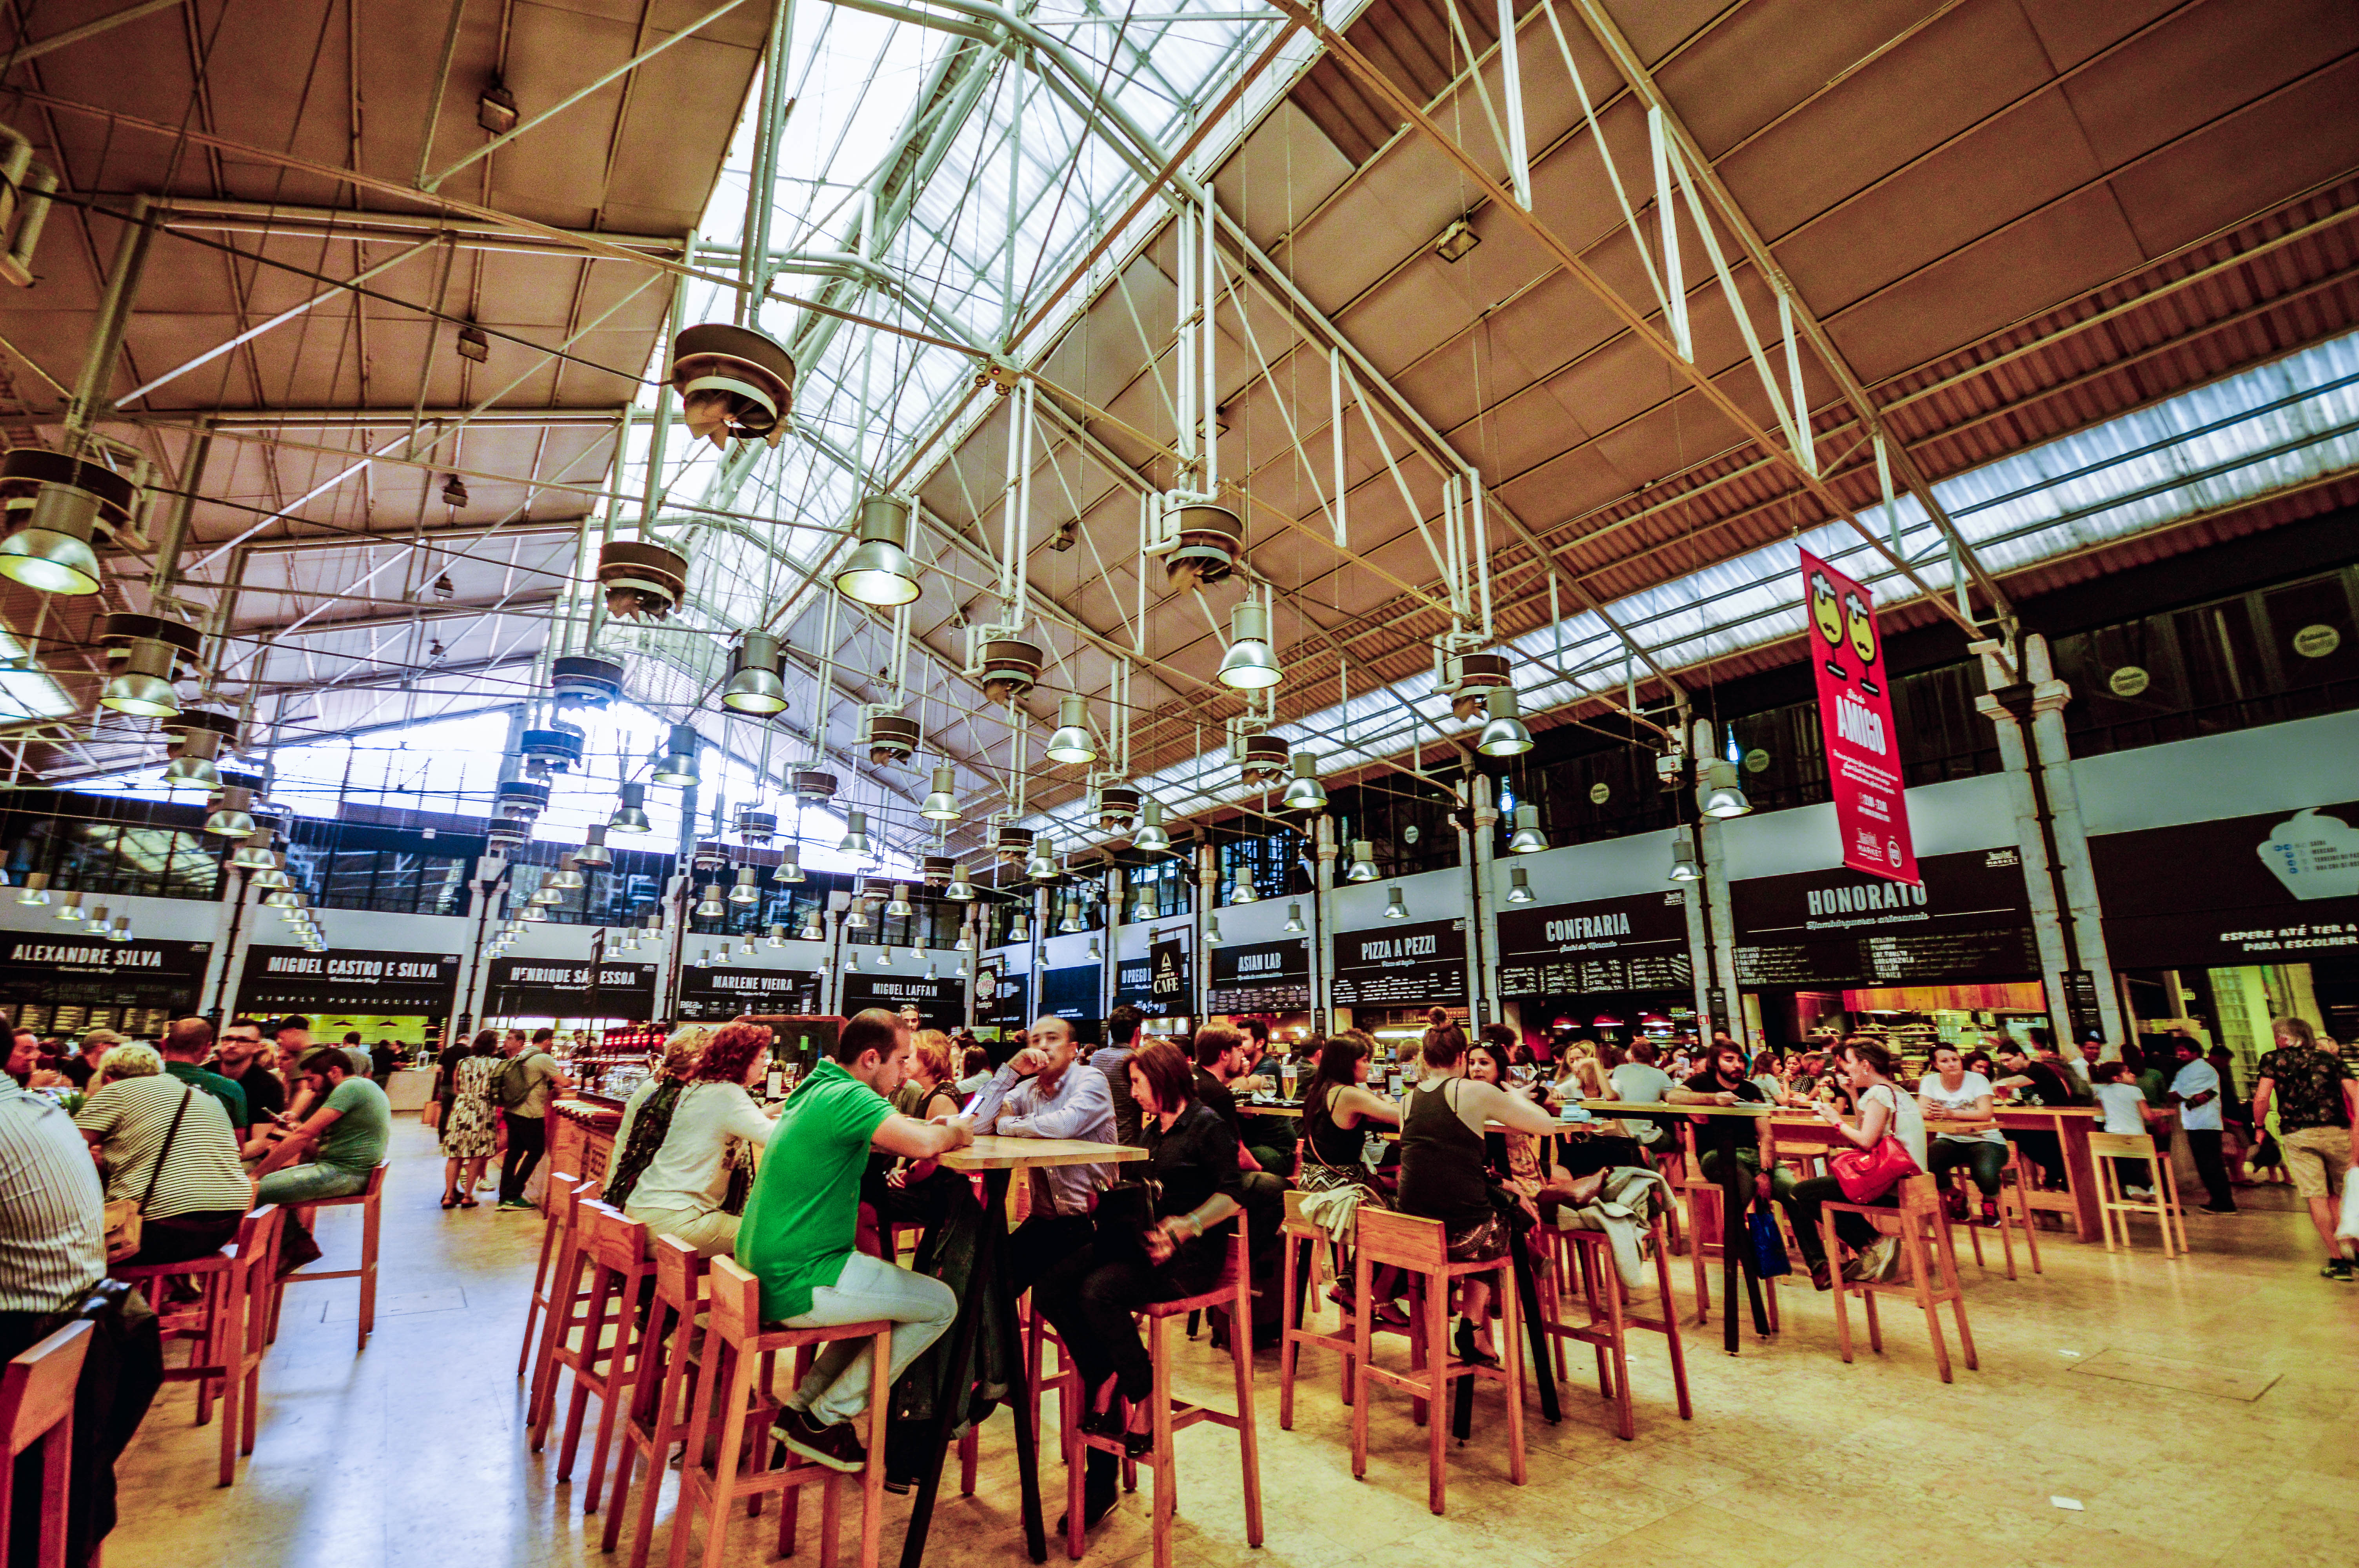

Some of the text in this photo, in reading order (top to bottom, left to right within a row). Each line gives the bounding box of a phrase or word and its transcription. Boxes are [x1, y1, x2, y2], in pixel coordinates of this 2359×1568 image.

[1836, 695, 1886, 755] AMIGO
[1857, 844, 1882, 858] MARKET
[1807, 880, 1927, 915] HONORATO
[1546, 913, 1630, 942] CONFRARIA
[1806, 912, 1930, 930] Hambúrgueres artesanais
[2220, 930, 2274, 941] ESPERE
[2279, 924, 2307, 936] ATÉ
[2312, 924, 2343, 934] TER
[1361, 935, 1436, 960] PIZZA A PEZZI
[1559, 944, 1578, 953] Sushi
[1587, 941, 1618, 950] Mercado
[2243, 936, 2359, 951] PARA ESCOLHER
[10, 944, 161, 967] ALEXANDRE SILVA
[1238, 953, 1281, 972] ASIAN LAB
[267, 957, 438, 978] MIGUEL CASTRO E SILVA
[510, 967, 635, 985] HENRIQUE SÁ ESSOA
[1122, 970, 1127, 984] O
[1127, 968, 1147, 983] PREGO
[712, 976, 793, 991] MARLENE VIEIRA
[872, 983, 938, 996] MIGUEL LAFFAN
